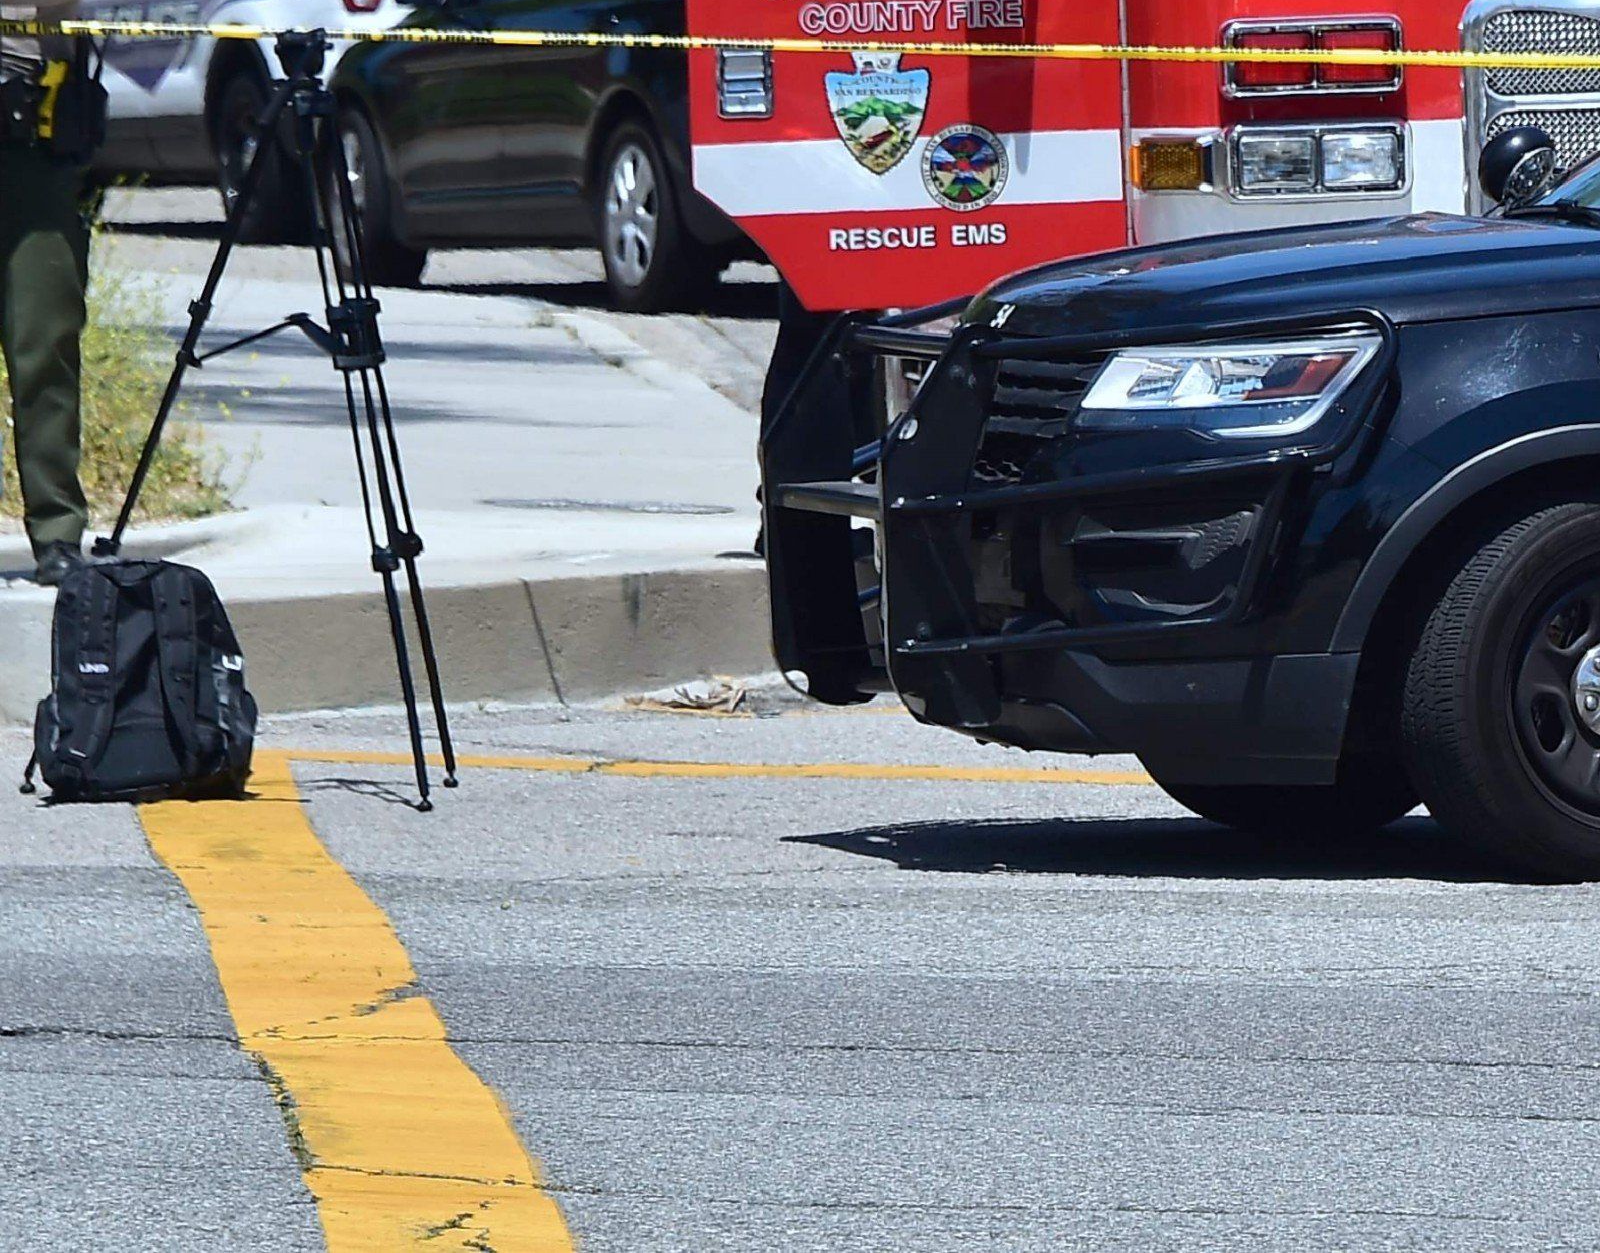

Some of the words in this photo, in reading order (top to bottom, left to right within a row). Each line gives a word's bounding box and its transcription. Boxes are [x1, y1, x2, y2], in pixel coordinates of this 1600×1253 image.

[798, 0, 941, 34] COUNTY
[829, 225, 936, 250] RESCUE
[951, 223, 1006, 246] EMS
